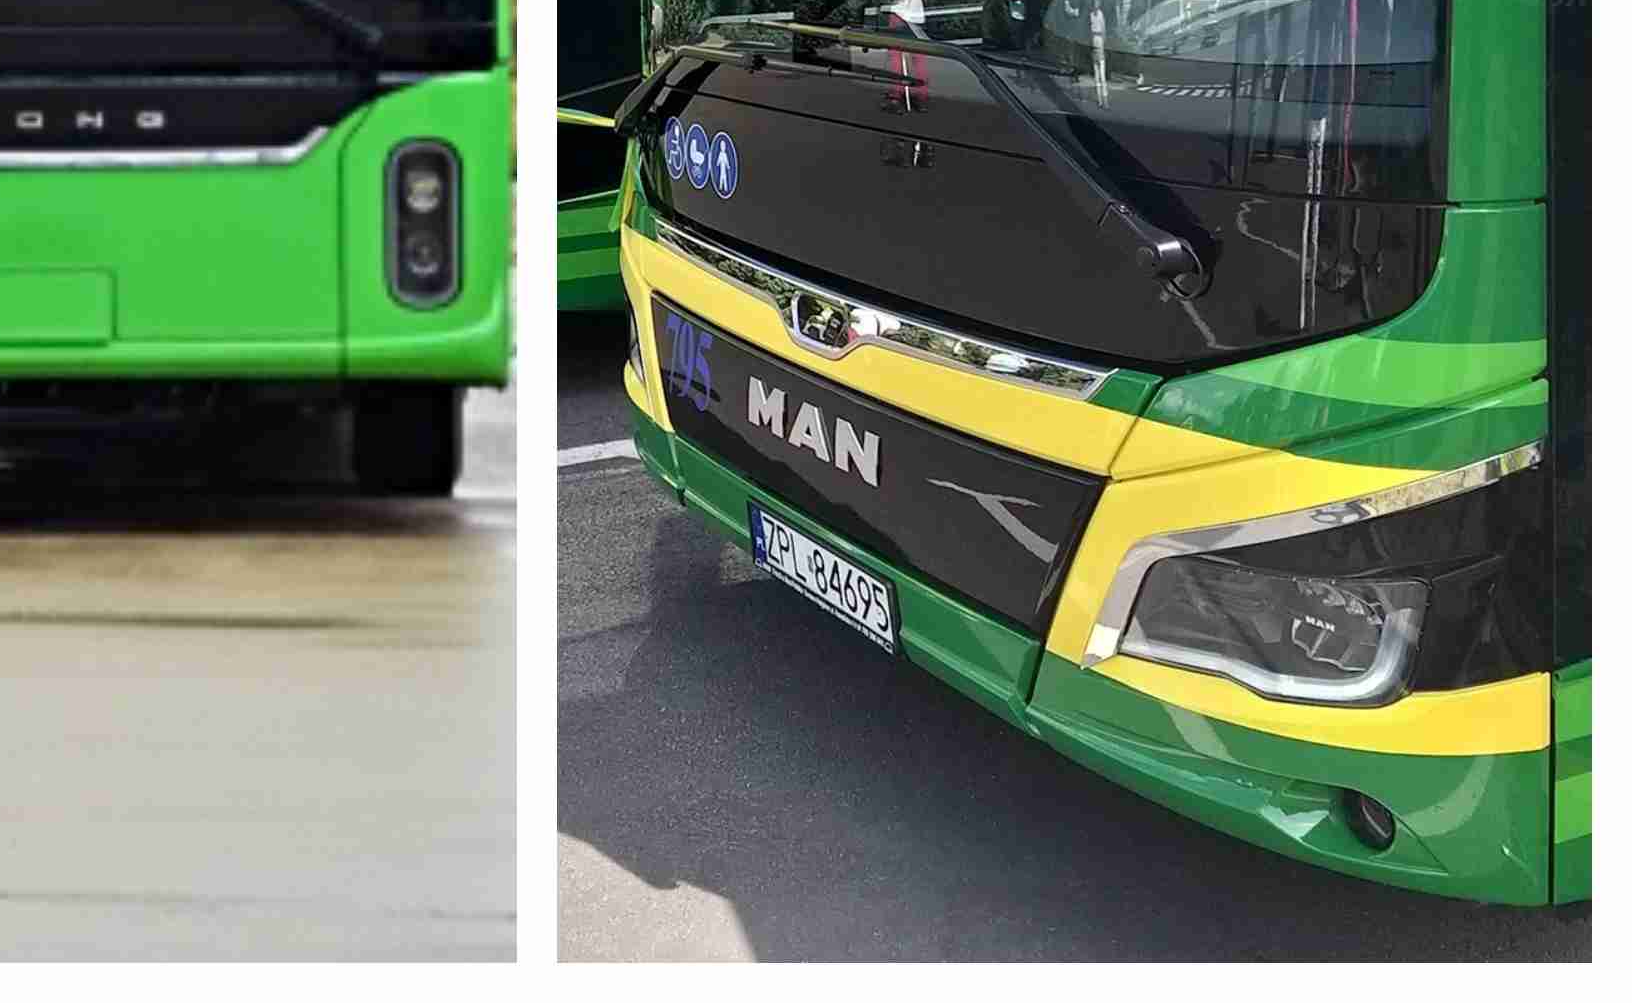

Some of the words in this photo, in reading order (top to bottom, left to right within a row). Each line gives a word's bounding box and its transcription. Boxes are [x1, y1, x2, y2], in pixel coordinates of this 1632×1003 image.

[748, 375, 881, 487] MAN
[763, 516, 806, 583] ZPL
[813, 549, 889, 632] 84695
